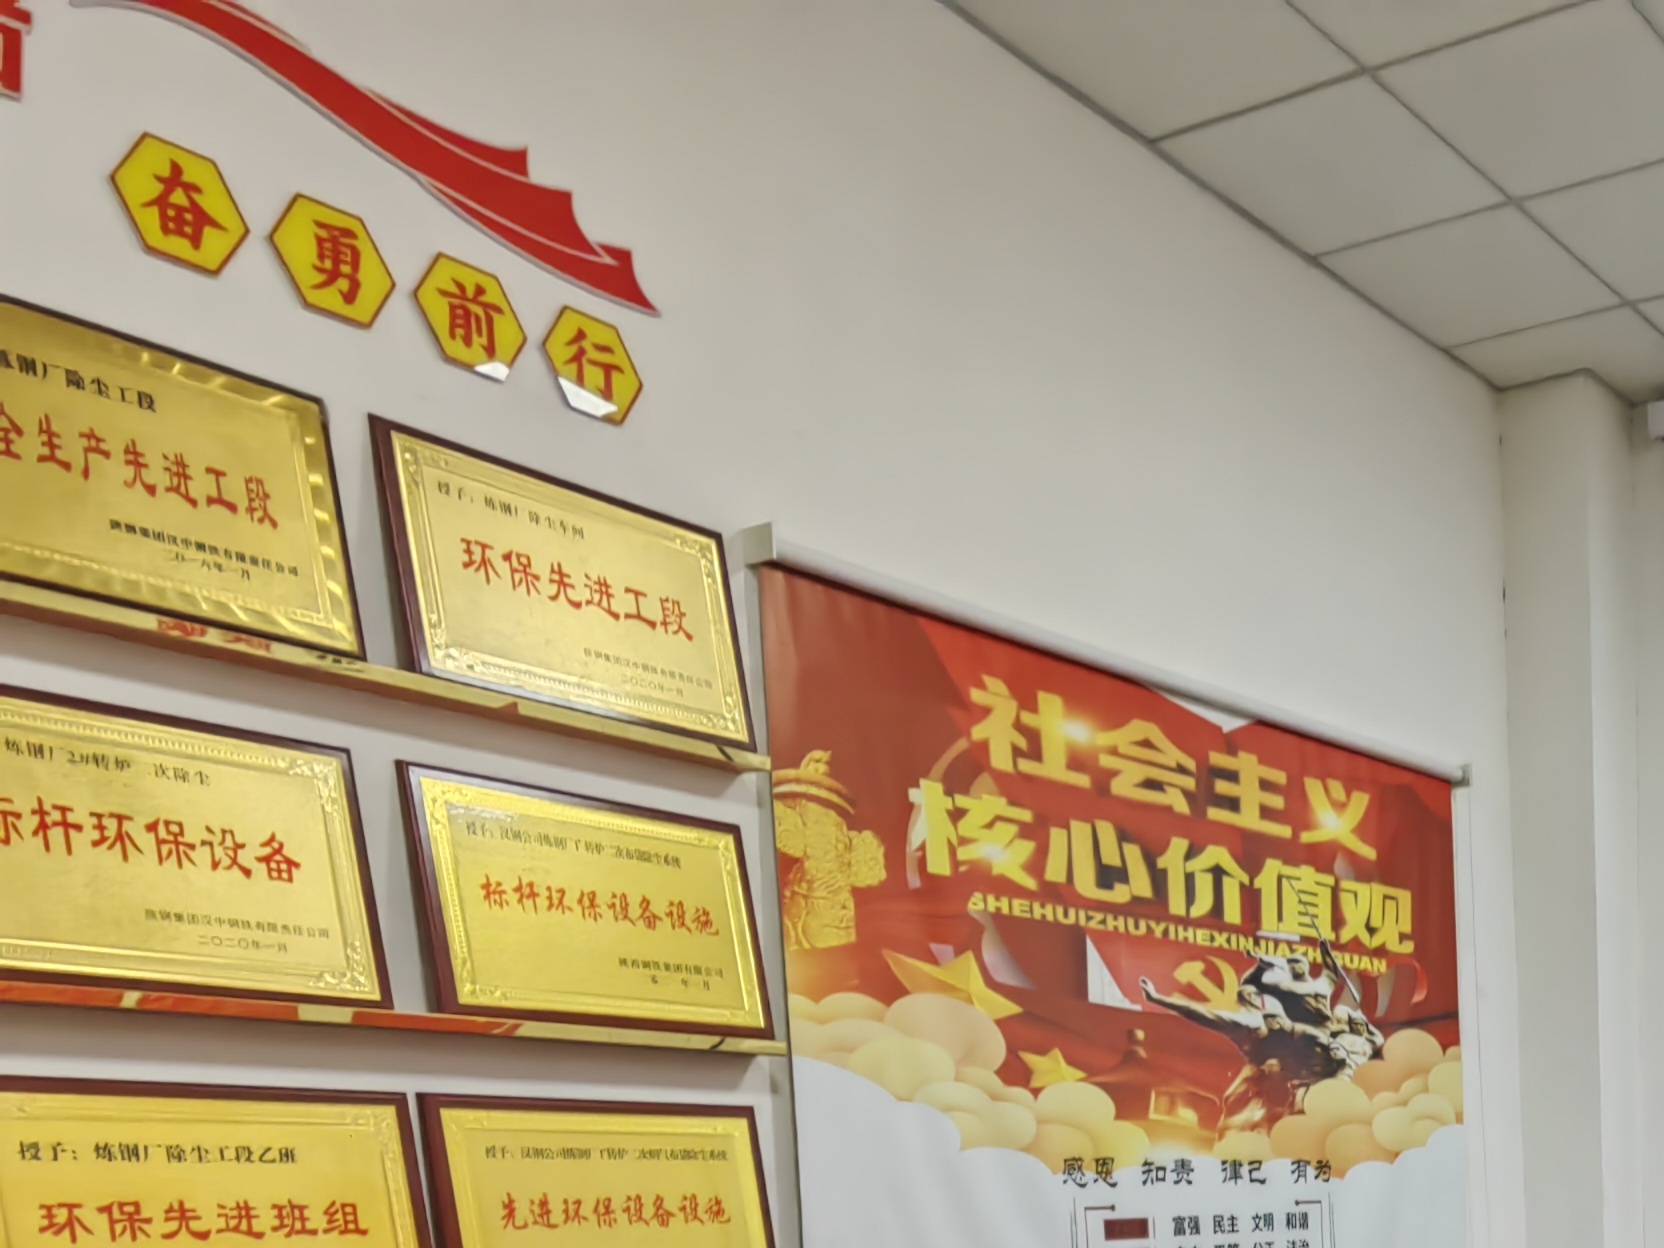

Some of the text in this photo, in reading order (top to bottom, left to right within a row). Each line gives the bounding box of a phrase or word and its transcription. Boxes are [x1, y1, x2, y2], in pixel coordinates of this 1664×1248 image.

[140, 157, 626, 404] 奋勇前行
[460, 537, 694, 642] 环保先进工段
[968, 673, 1378, 861] 社会主义
[908, 777, 1415, 954] 核心价值观
[480, 873, 720, 937] 标杆环保设备设施
[967, 890, 1387, 974] SHEHUIZHUYIHEXINJIAZHGUAN
[1062, 1156, 1332, 1189] 感恩 知责 律己 有为
[38, 1198, 370, 1245] 环保先进班组
[500, 1191, 732, 1231] 先进环保设备设施
[1172, 1211, 1310, 1237] 富强 民主 文明 和谐
